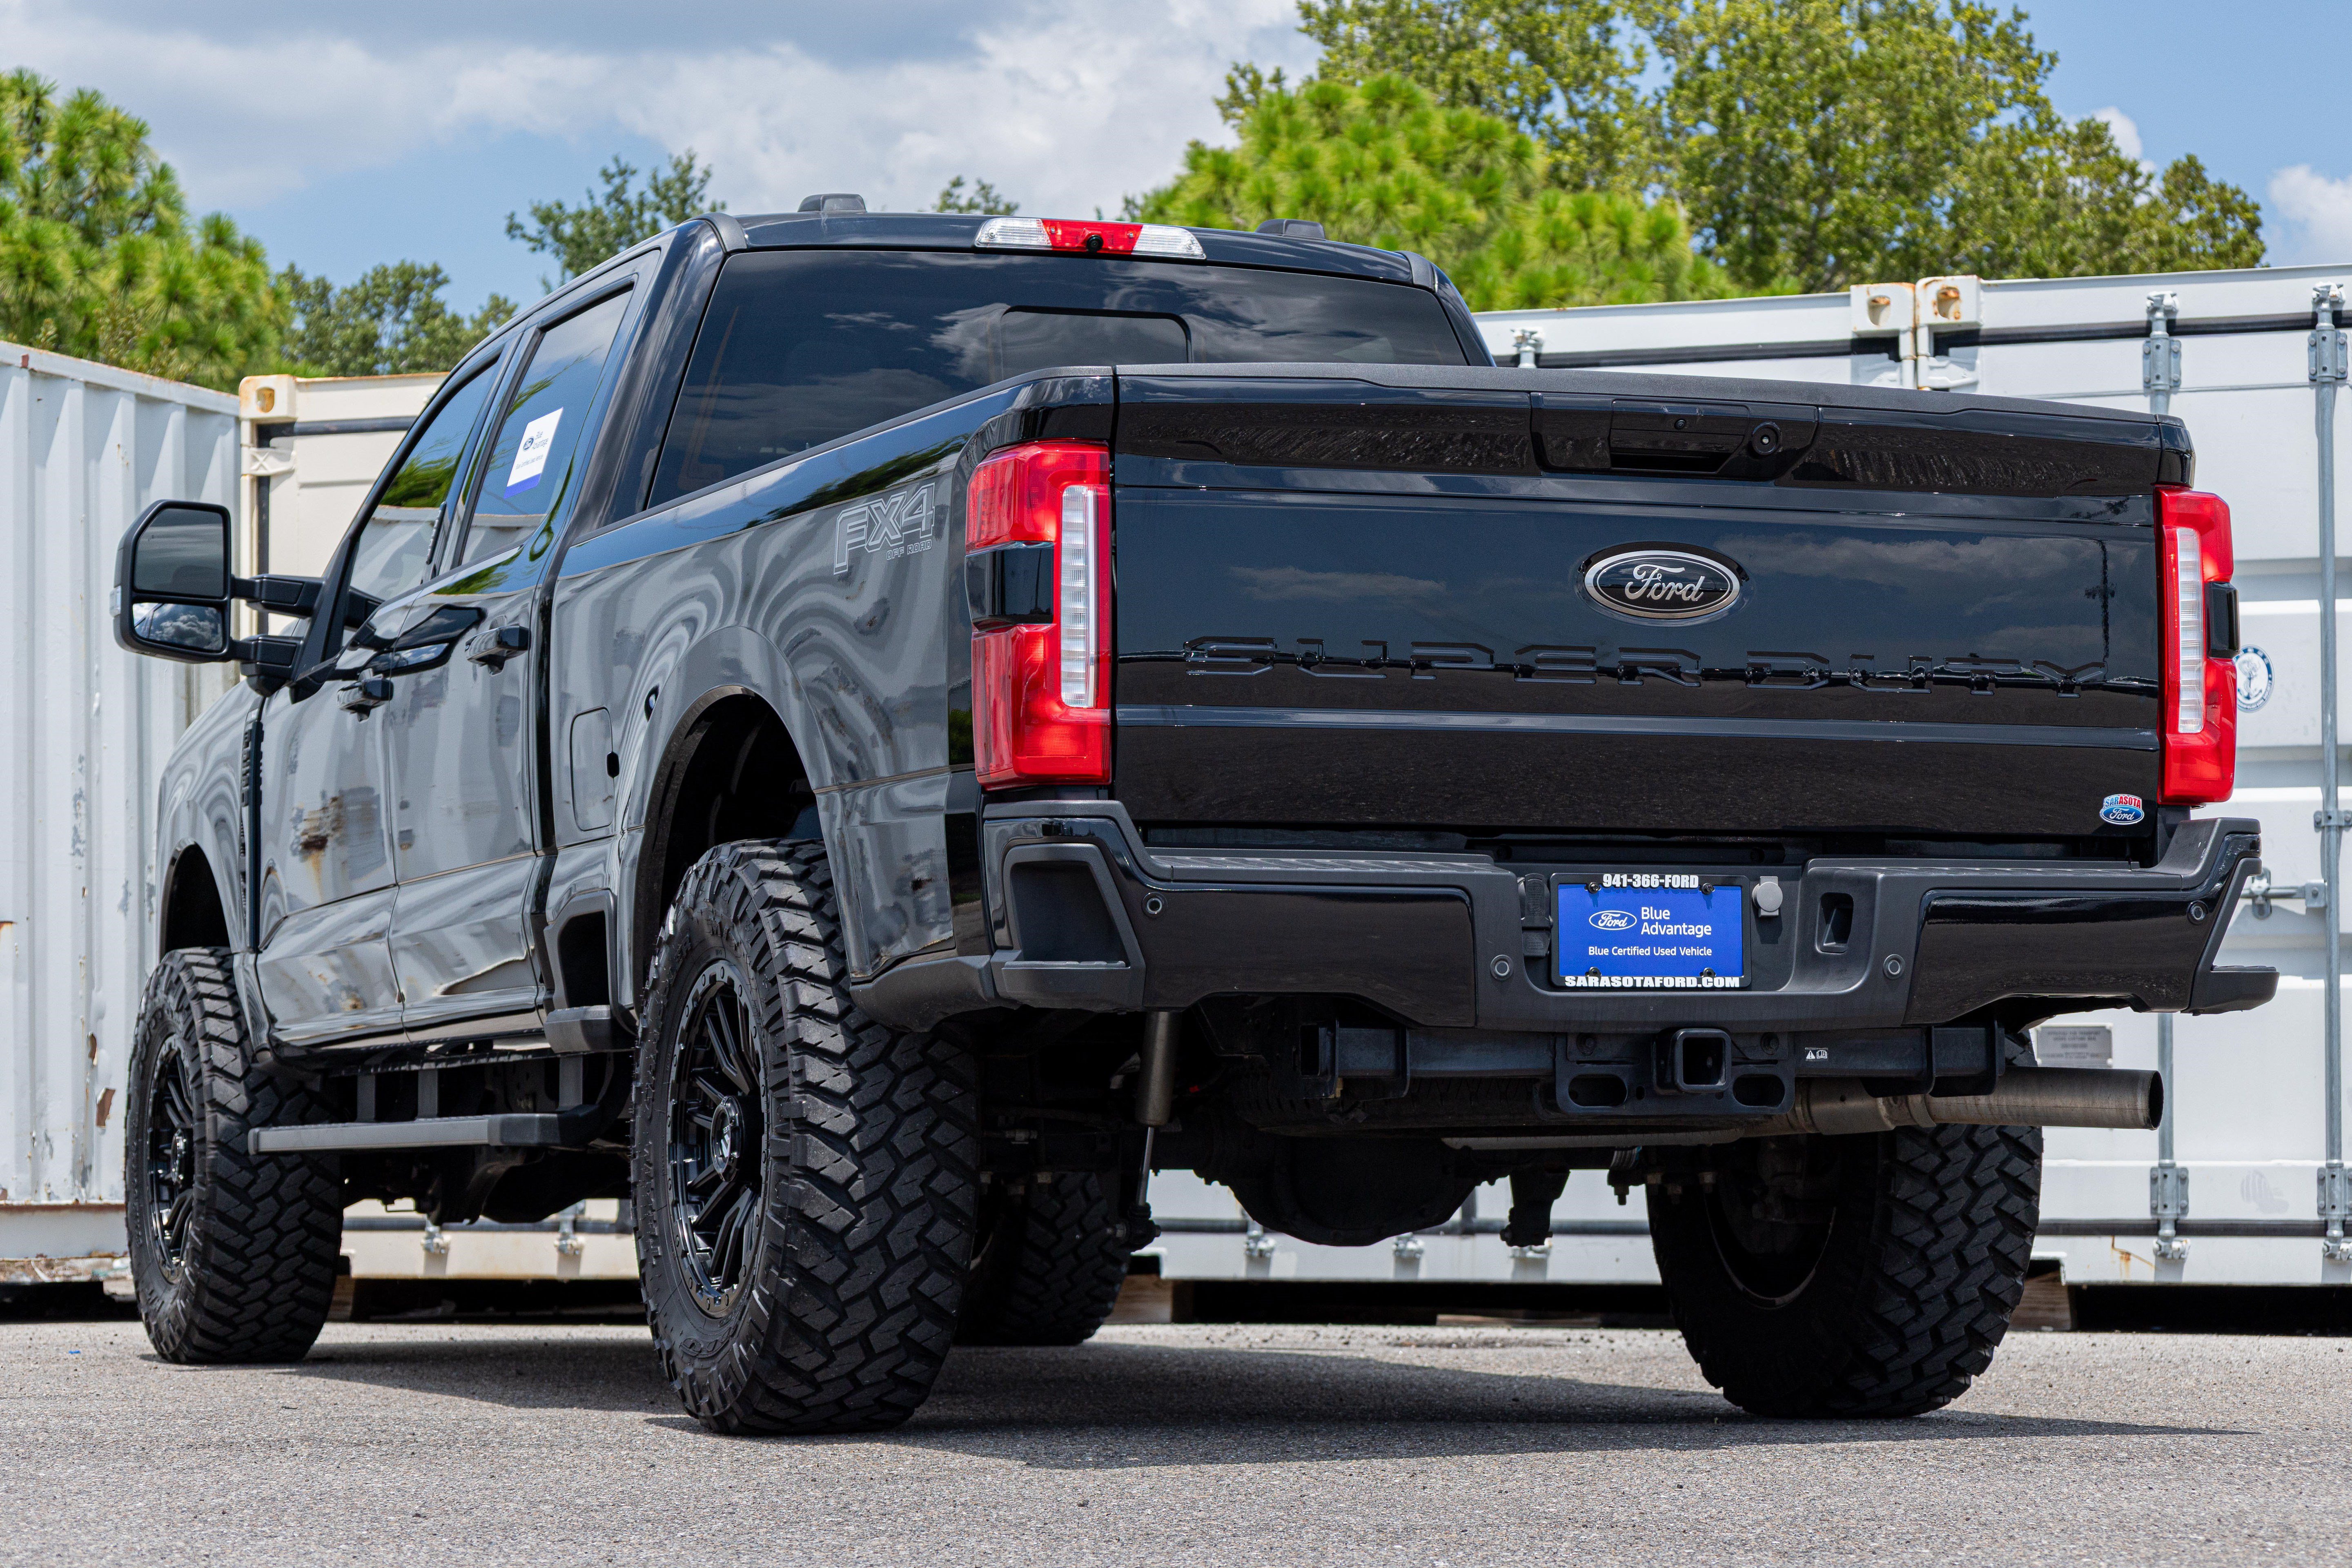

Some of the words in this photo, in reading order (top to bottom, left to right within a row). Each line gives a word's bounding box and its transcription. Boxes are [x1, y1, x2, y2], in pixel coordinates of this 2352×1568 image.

[833, 482, 935, 575] FX4
[886, 546, 904, 560] OFF
[907, 539, 932, 555] ROAD
[1624, 564, 1706, 602] Ford
[1183, 635, 1702, 688] SUPER
[1746, 651, 2106, 698] DUTY
[2105, 796, 2141, 809] SARASOTA
[2109, 807, 2135, 820] Ford
[1602, 874, 1699, 888] 941-366-FORD
[1597, 913, 1628, 927] Ford
[1641, 906, 1670, 920] Blue
[1641, 922, 1712, 938] Advantage
[1588, 946, 1609, 956] Blue
[1611, 946, 1650, 956] Certified
[1653, 946, 1676, 956] Used
[1679, 947, 1712, 956] Vehicle
[1565, 976, 1740, 988] SARASOTAFORD.COM
